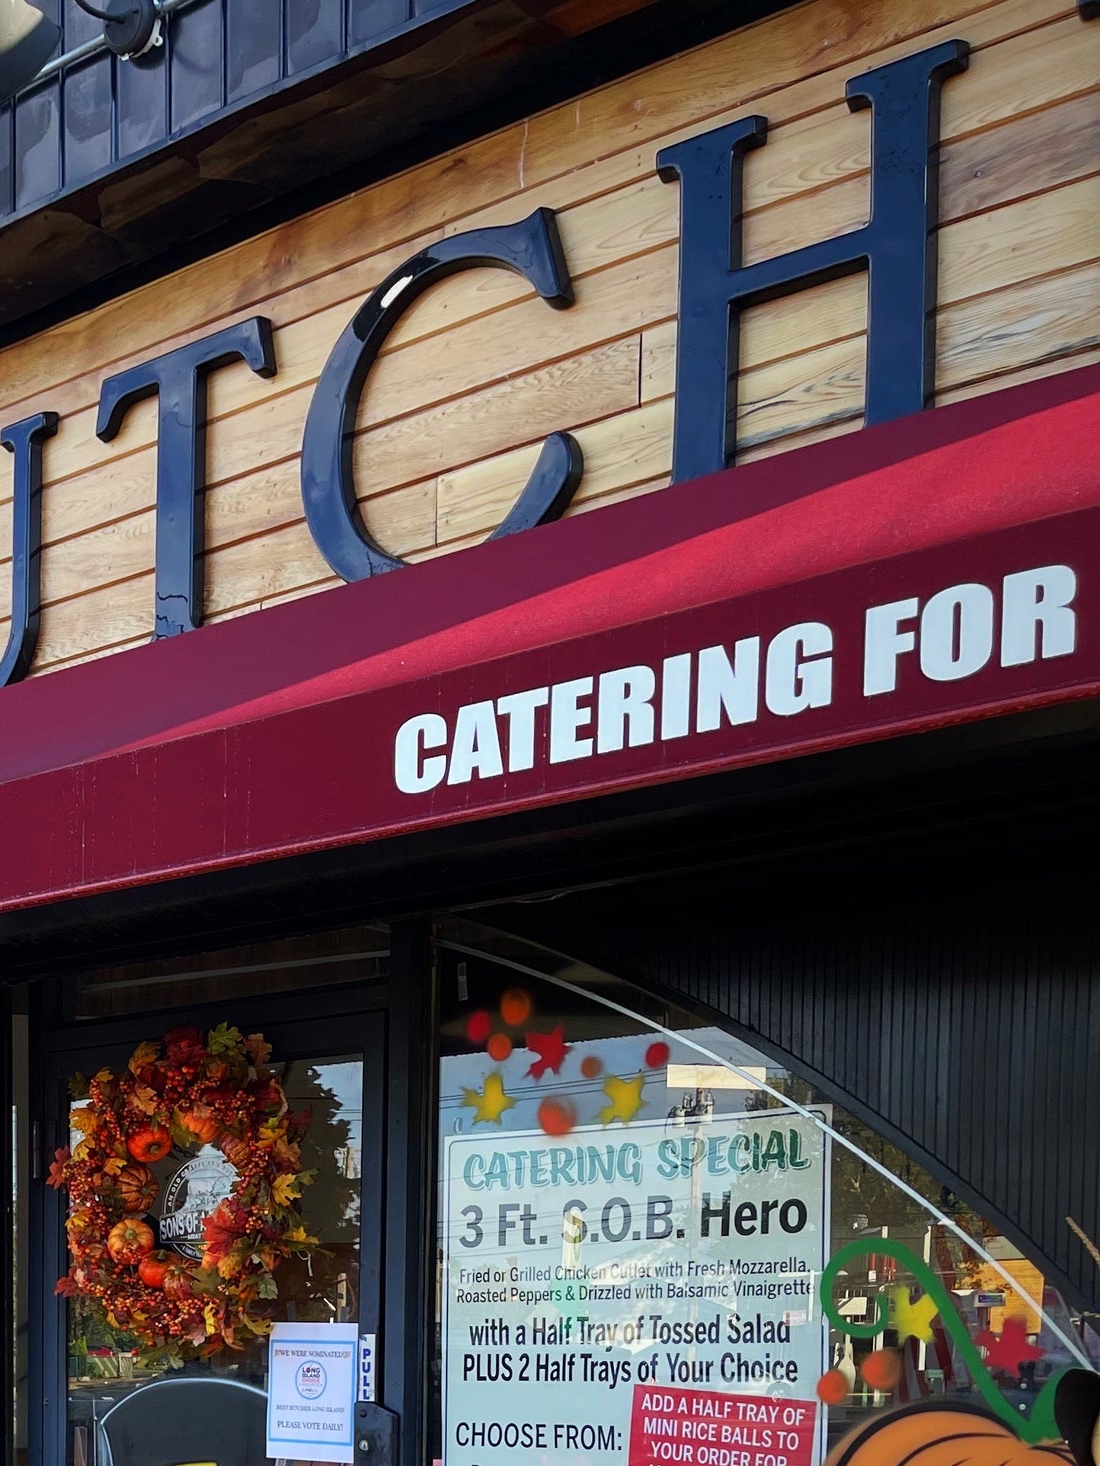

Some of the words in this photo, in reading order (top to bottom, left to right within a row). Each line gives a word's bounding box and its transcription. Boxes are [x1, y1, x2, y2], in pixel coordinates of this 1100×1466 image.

[393, 618, 836, 795] CATERING
[861, 563, 1078, 698] FOR
[463, 1141, 643, 1190] CATERING
[656, 1128, 812, 1180] SPECIAL
[160, 1215, 185, 1240] SONS
[187, 1212, 199, 1234] OF
[459, 1204, 484, 1248] 3
[498, 1202, 548, 1247] Ft.
[562, 1194, 685, 1244] S.O.B.
[700, 1191, 807, 1239] Hero
[459, 1267, 490, 1284] Fried
[493, 1271, 506, 1283] or
[510, 1265, 551, 1283] Grilled
[555, 1264, 607, 1281] Chicken
[611, 1262, 651, 1279] Cutlet
[654, 1261, 684, 1277] with
[687, 1260, 725, 1276] Fresh
[457, 1286, 506, 1303] Roasted
[510, 1287, 562, 1306] Peppers
[565, 1285, 575, 1301] &
[579, 1283, 631, 1301] Drizzled
[635, 1283, 663, 1299] with
[667, 1282, 729, 1299] Balsamic
[732, 1278, 814, 1301] Vinaigrette
[469, 1319, 510, 1346] with
[514, 1327, 524, 1346] a
[532, 1316, 573, 1346] Half
[577, 1316, 619, 1352] Tray
[623, 1315, 644, 1345] of
[649, 1313, 721, 1345] Tossed
[727, 1313, 790, 1344] Salad
[302, 1366, 320, 1374] LONG
[362, 1348, 371, 1400] PULL
[463, 1353, 513, 1383] PLUS
[518, 1353, 530, 1382] 2
[535, 1353, 575, 1382] Half
[579, 1354, 632, 1389] Trays
[637, 1354, 658, 1382] of
[666, 1354, 714, 1383] Your
[720, 1352, 798, 1383] Choice
[277, 1420, 300, 1429] PLEASE
[301, 1421, 321, 1430] VOTE
[641, 1393, 675, 1414] ADD
[677, 1396, 688, 1415] A
[692, 1397, 733, 1419] HALF
[736, 1402, 779, 1423] TRAY
[783, 1405, 805, 1426] OF
[455, 1422, 547, 1450] CHOOSE
[553, 1424, 623, 1452] FROM:
[643, 1417, 678, 1439] MINI
[682, 1420, 716, 1442] RICE
[720, 1425, 772, 1448] BALLS
[777, 1430, 799, 1451] TO
[651, 1440, 693, 1463] YOUR
